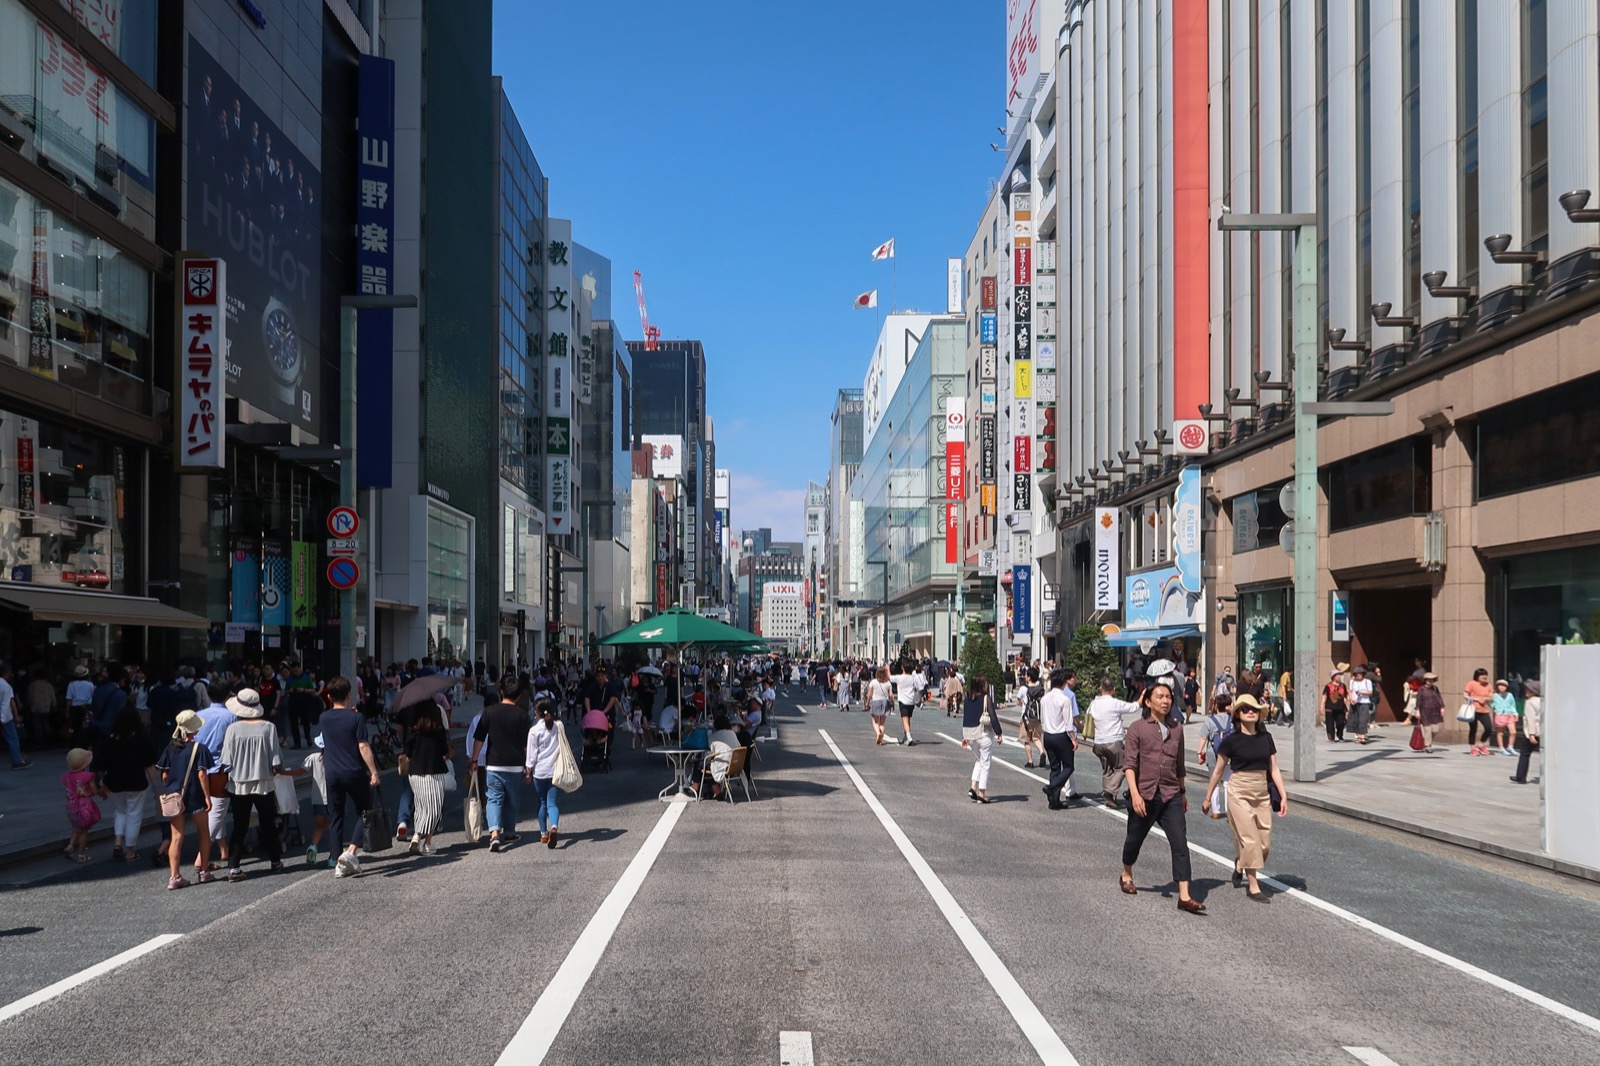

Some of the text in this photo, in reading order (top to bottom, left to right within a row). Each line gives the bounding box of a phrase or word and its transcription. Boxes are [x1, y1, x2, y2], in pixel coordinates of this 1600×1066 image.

[203, 183, 310, 300] HUBLOT
[362, 136, 388, 295] 山野楽器
[548, 240, 568, 357] 教文館
[187, 313, 214, 455] キムラヤのパン
[548, 423, 567, 449] 本
[772, 585, 796, 594] LIXIL
[1098, 549, 1109, 606] MOTOKI
